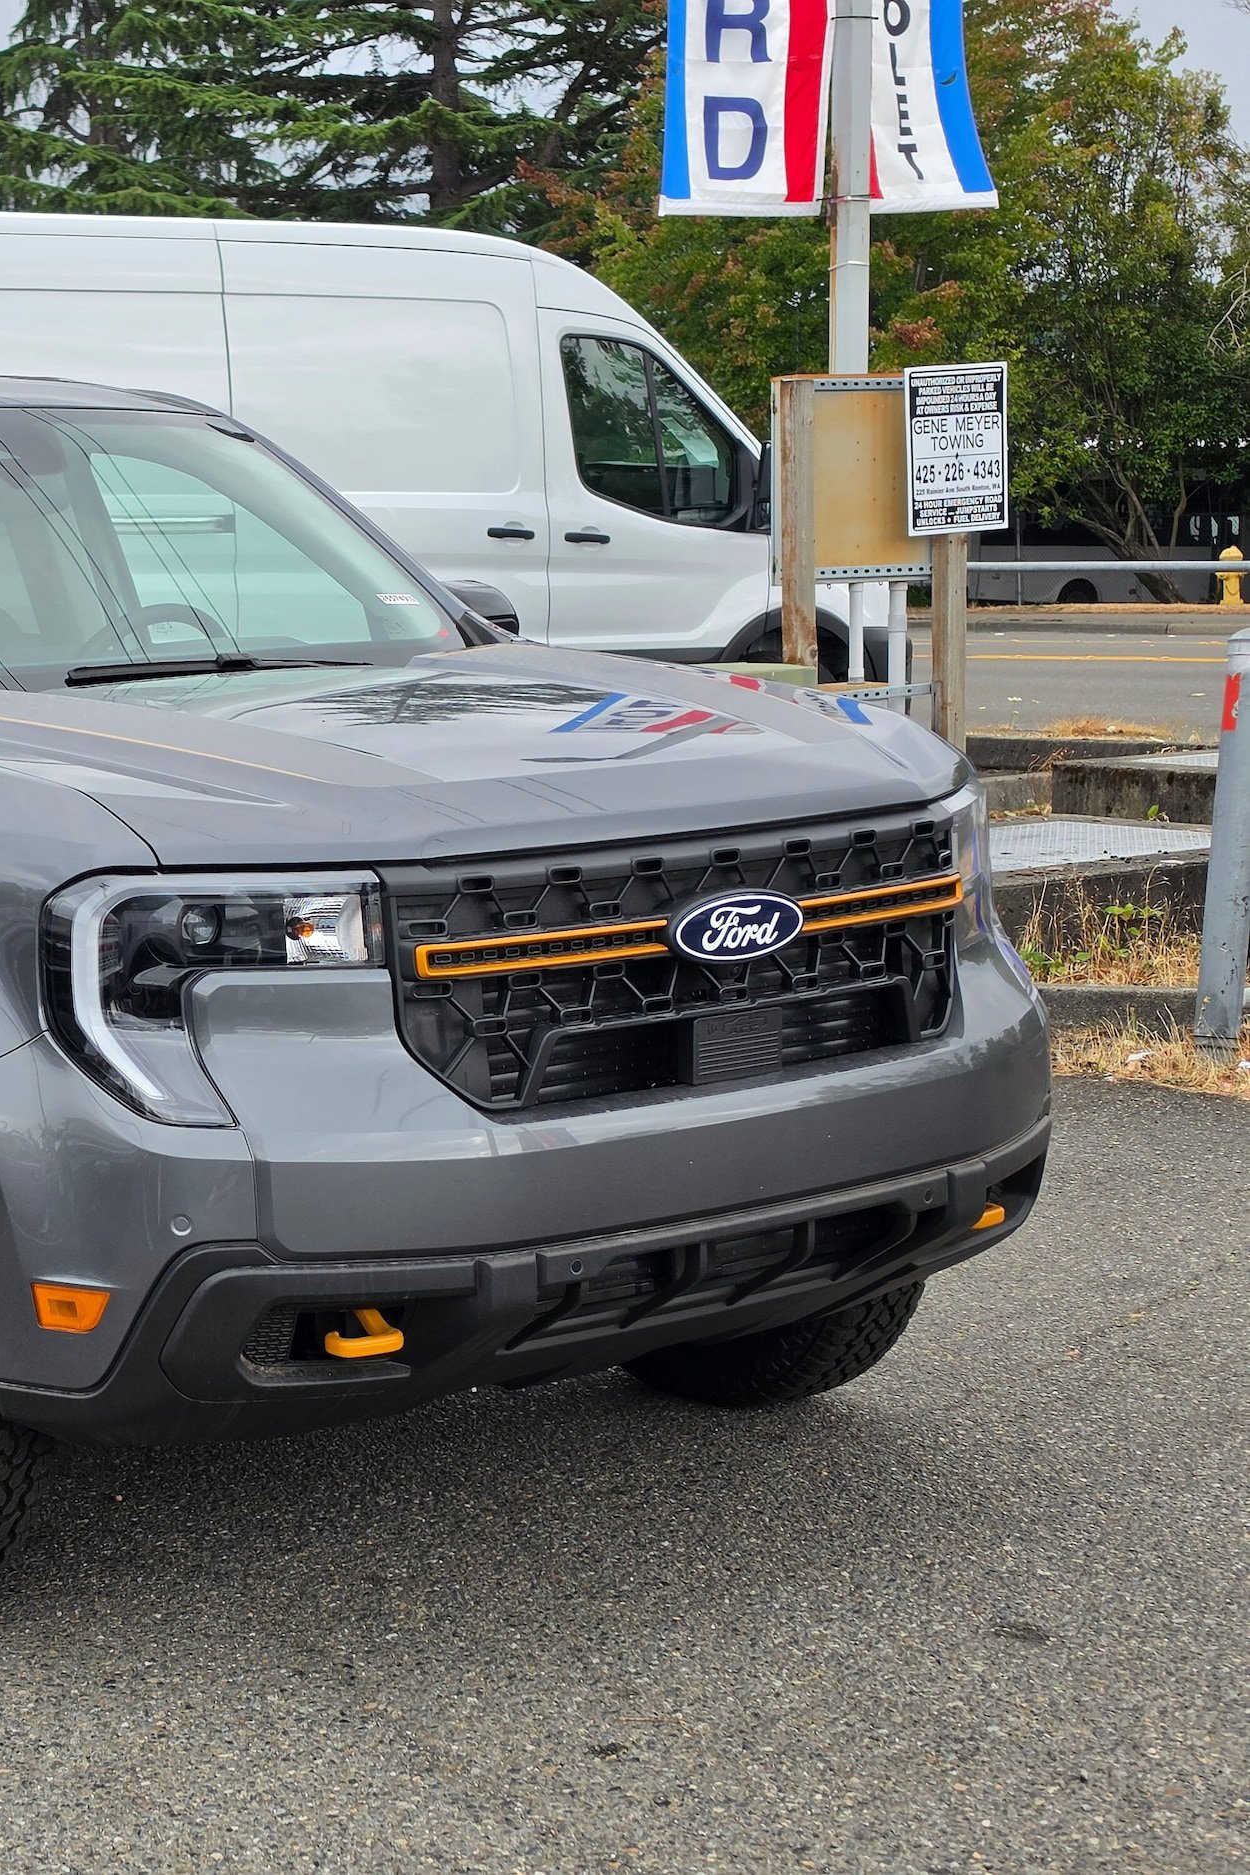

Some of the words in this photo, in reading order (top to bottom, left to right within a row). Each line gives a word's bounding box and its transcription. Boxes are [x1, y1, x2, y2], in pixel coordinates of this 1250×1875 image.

[911, 377, 956, 387] UNAUTHORIZED
[956, 376, 965, 384] OR
[965, 373, 1002, 384] IMPROPERLY
[918, 387, 942, 396] PARKED
[942, 384, 970, 394] VEHICLES
[971, 383, 985, 392] WILL
[986, 382, 995, 391] BE
[915, 395, 950, 405] IMPOUNDED
[950, 394, 958, 403] 24
[958, 393, 979, 403] HOURS
[985, 391, 997, 401] DAY
[916, 406, 924, 415] AT
[949, 403, 964, 413] RISK
[970, 401, 998, 411] EXPENSE
[913, 418, 948, 435] GENE
[955, 415, 1000, 432] MEYER
[930, 433, 984, 451] TOWING
[916, 488, 925, 496] 225
[926, 487, 945, 495] Rainier
[956, 485, 970, 493] South
[914, 502, 923, 510] 24
[923, 500, 943, 509] HOUR
[943, 496, 984, 507] EMERGENCY
[984, 495, 1003, 504] ROAD
[919, 507, 948, 518] SERVICE
[955, 503, 998, 515] JUMPSTARTS
[916, 516, 946, 527] UNLOCKS
[953, 514, 970, 524] FUEL
[970, 511, 1001, 522] DELIVERY
[701, 904, 781, 952] Ford
